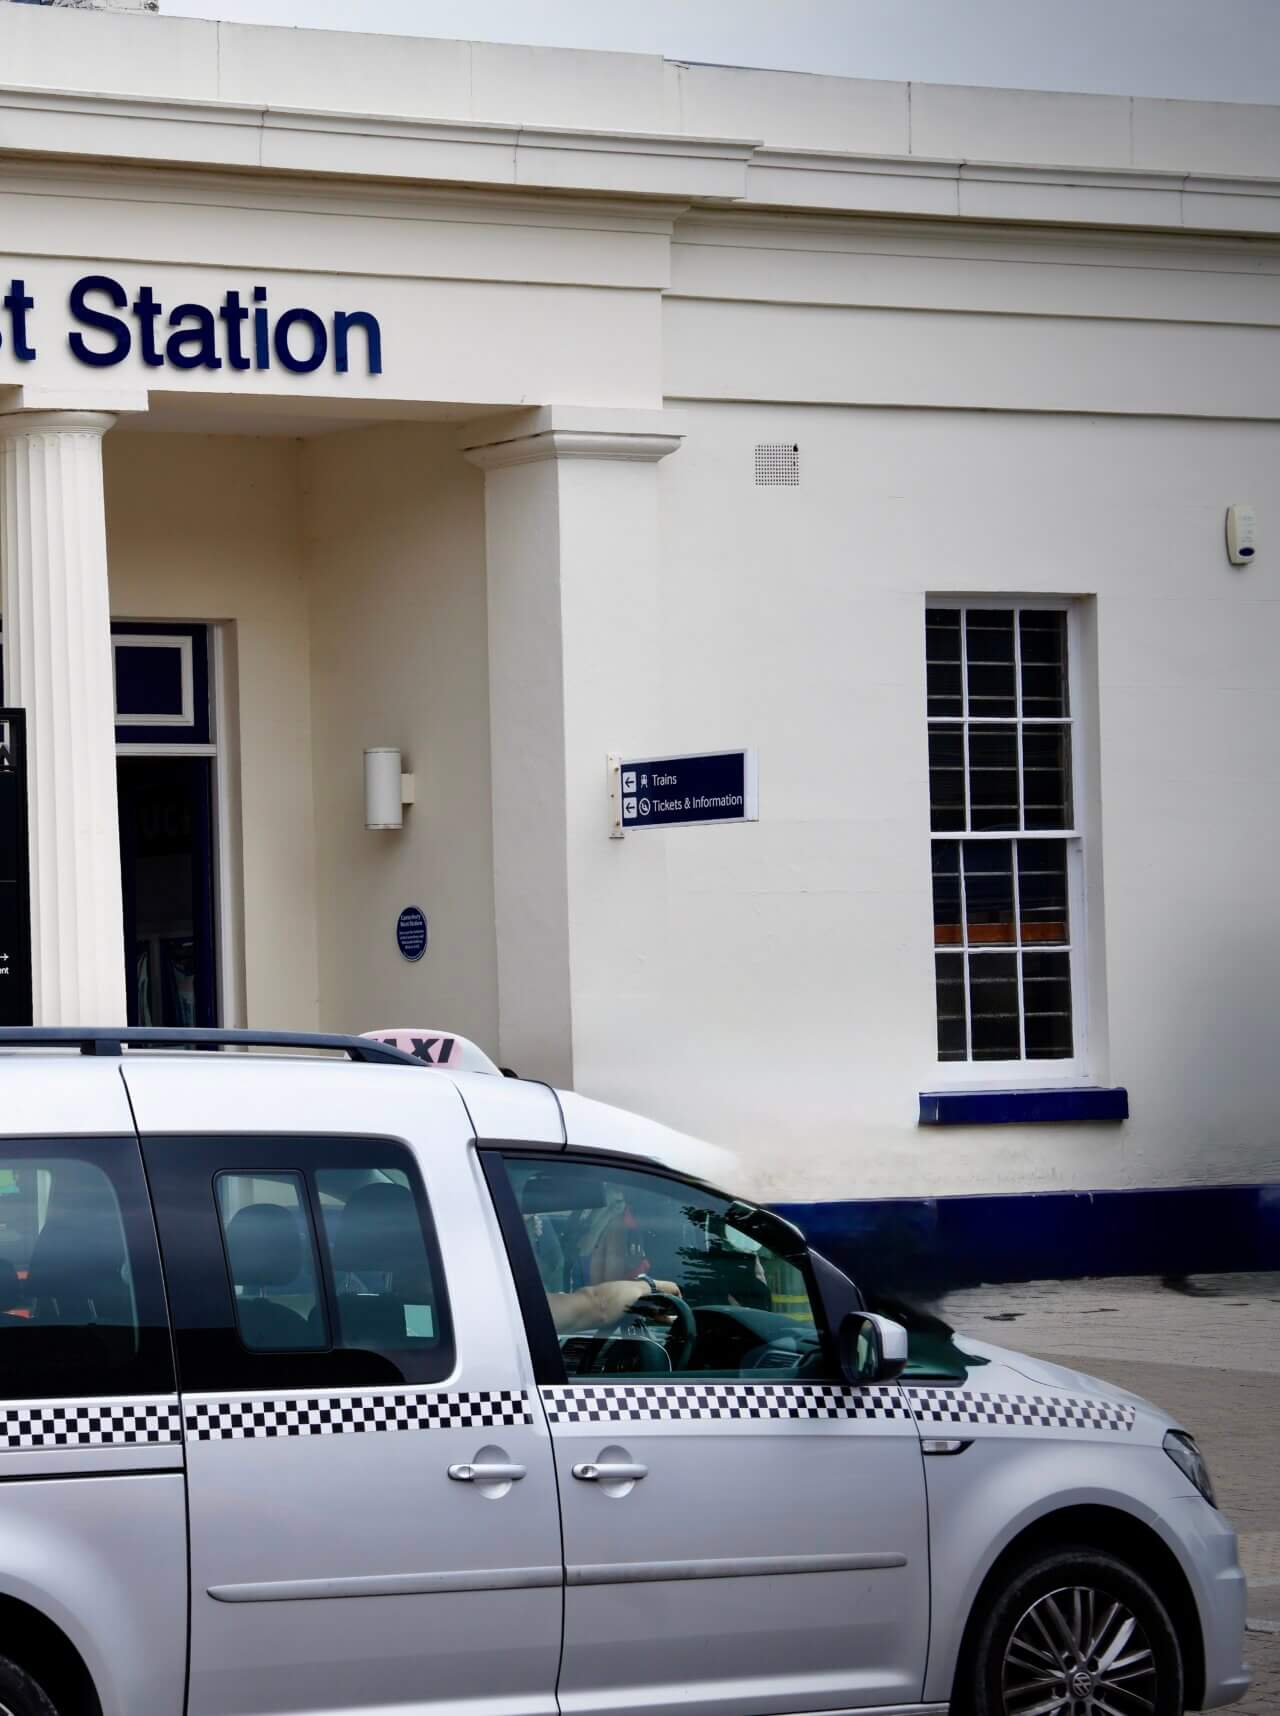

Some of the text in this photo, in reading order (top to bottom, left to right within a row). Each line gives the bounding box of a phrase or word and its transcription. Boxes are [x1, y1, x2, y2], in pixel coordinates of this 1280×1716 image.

[69, 275, 382, 375] Station
[651, 773, 677, 787] Trains
[653, 793, 743, 812] Tickets & Information
